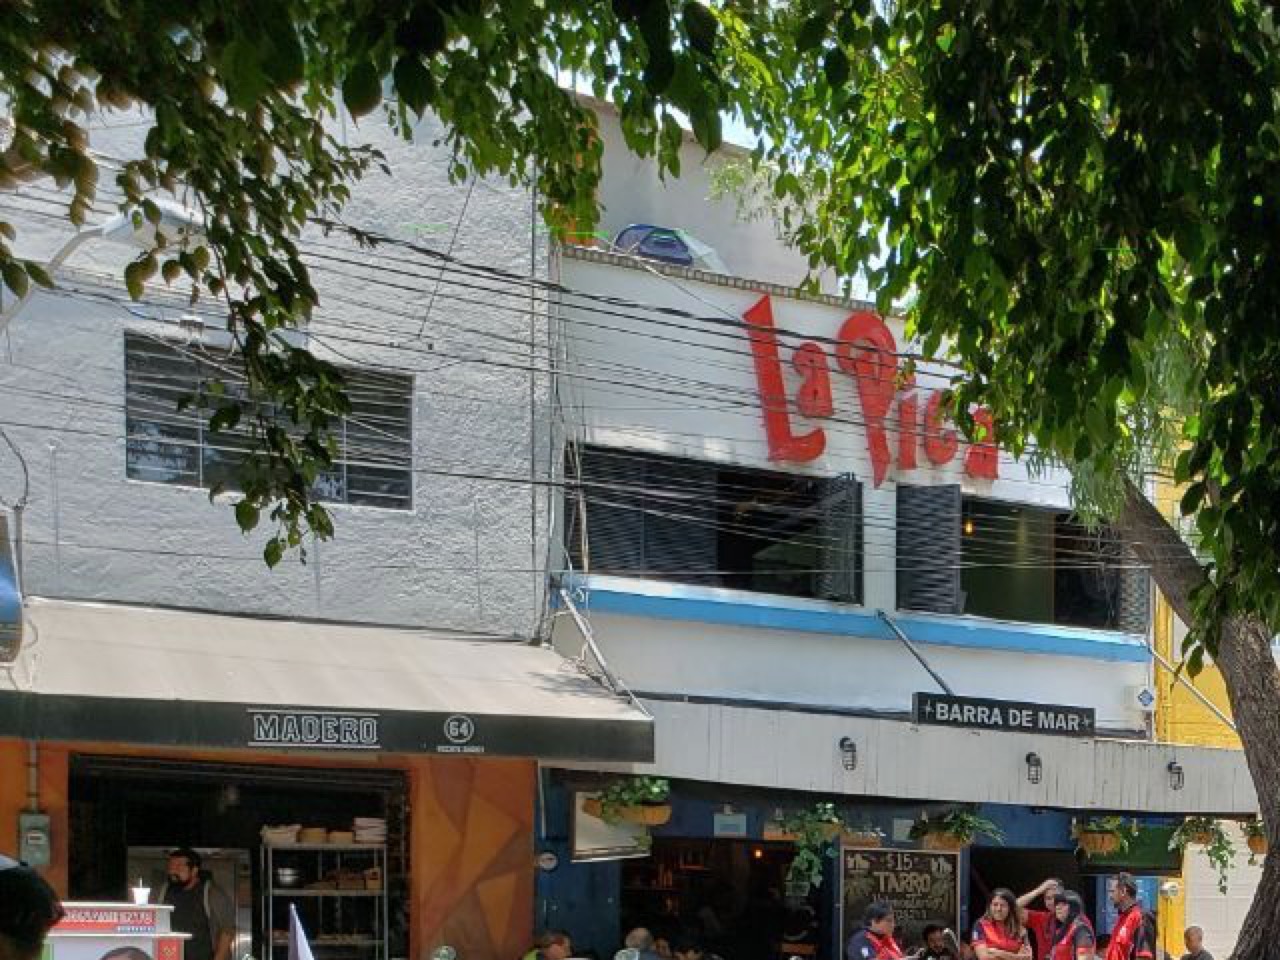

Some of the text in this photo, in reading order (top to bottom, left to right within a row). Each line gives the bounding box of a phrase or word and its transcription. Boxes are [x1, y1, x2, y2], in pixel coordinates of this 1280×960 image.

[741, 293, 835, 464] La
[253, 714, 377, 744] MADERO
[449, 721, 469, 737] 64
[935, 702, 1080, 731] BARRA DE MAR
[873, 871, 931, 893] TARRO
